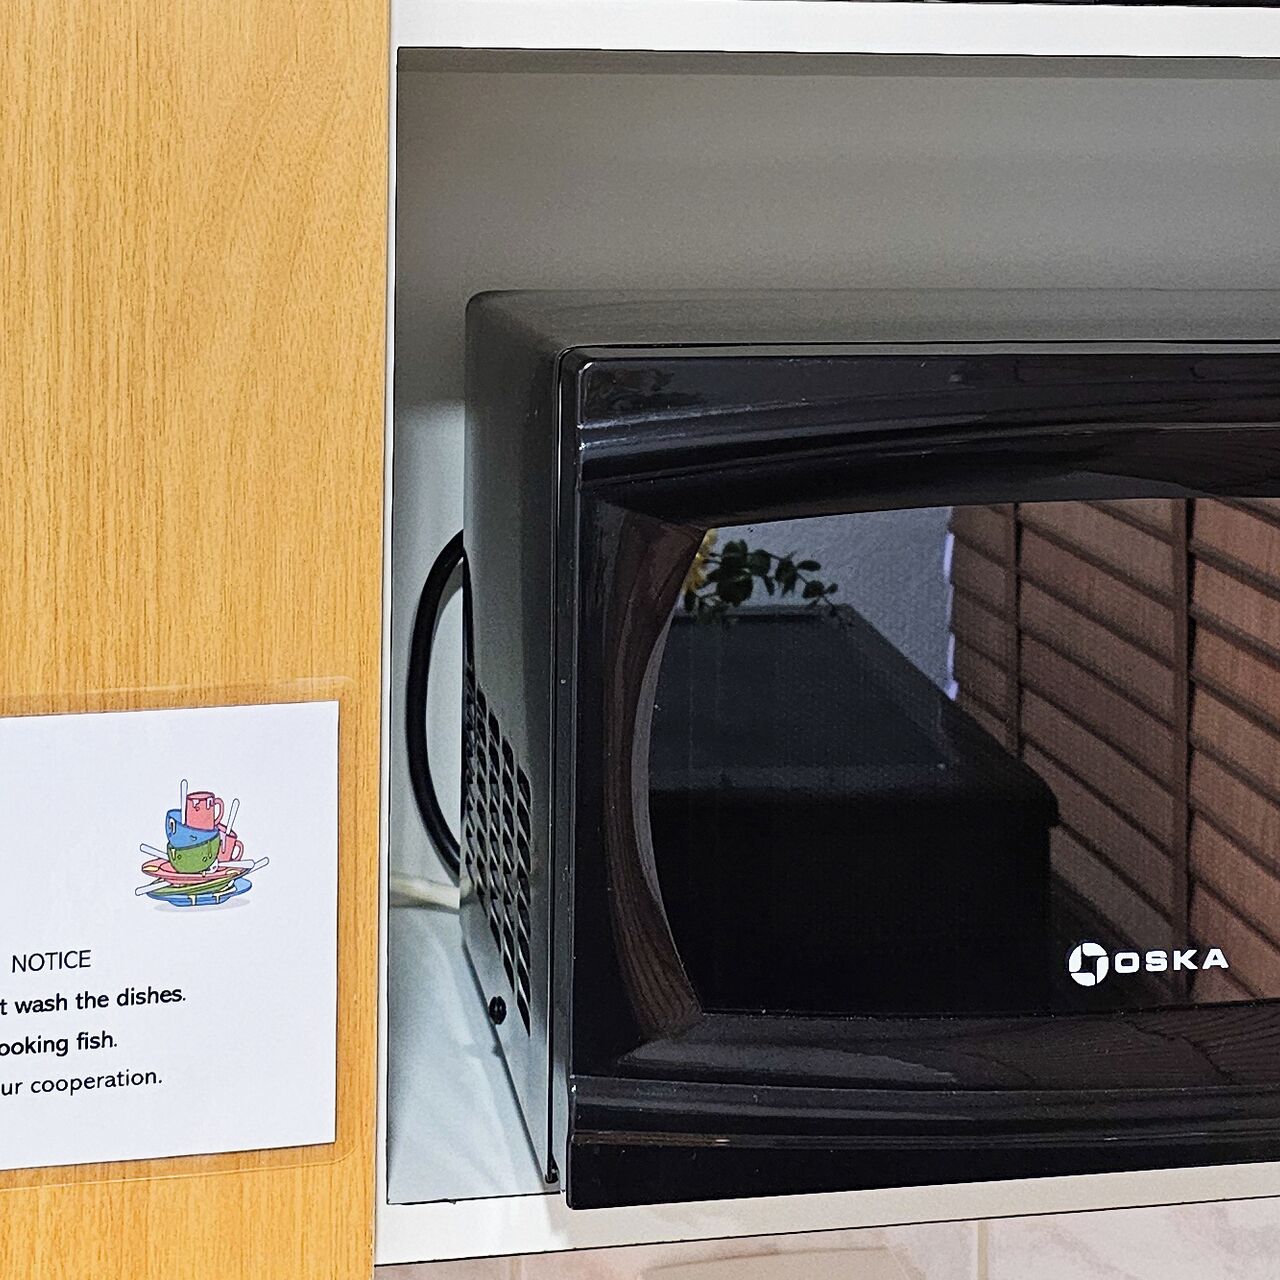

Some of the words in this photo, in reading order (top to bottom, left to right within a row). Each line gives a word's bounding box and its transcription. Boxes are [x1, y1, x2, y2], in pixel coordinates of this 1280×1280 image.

[12, 950, 91, 973] NOTICE
[1115, 948, 1229, 973] OSKA
[15, 993, 67, 1013] wash
[75, 991, 109, 1009] the
[117, 986, 185, 1006] dishes.
[77, 1030, 117, 1050] fish.
[31, 1069, 162, 1096] cooperation.
